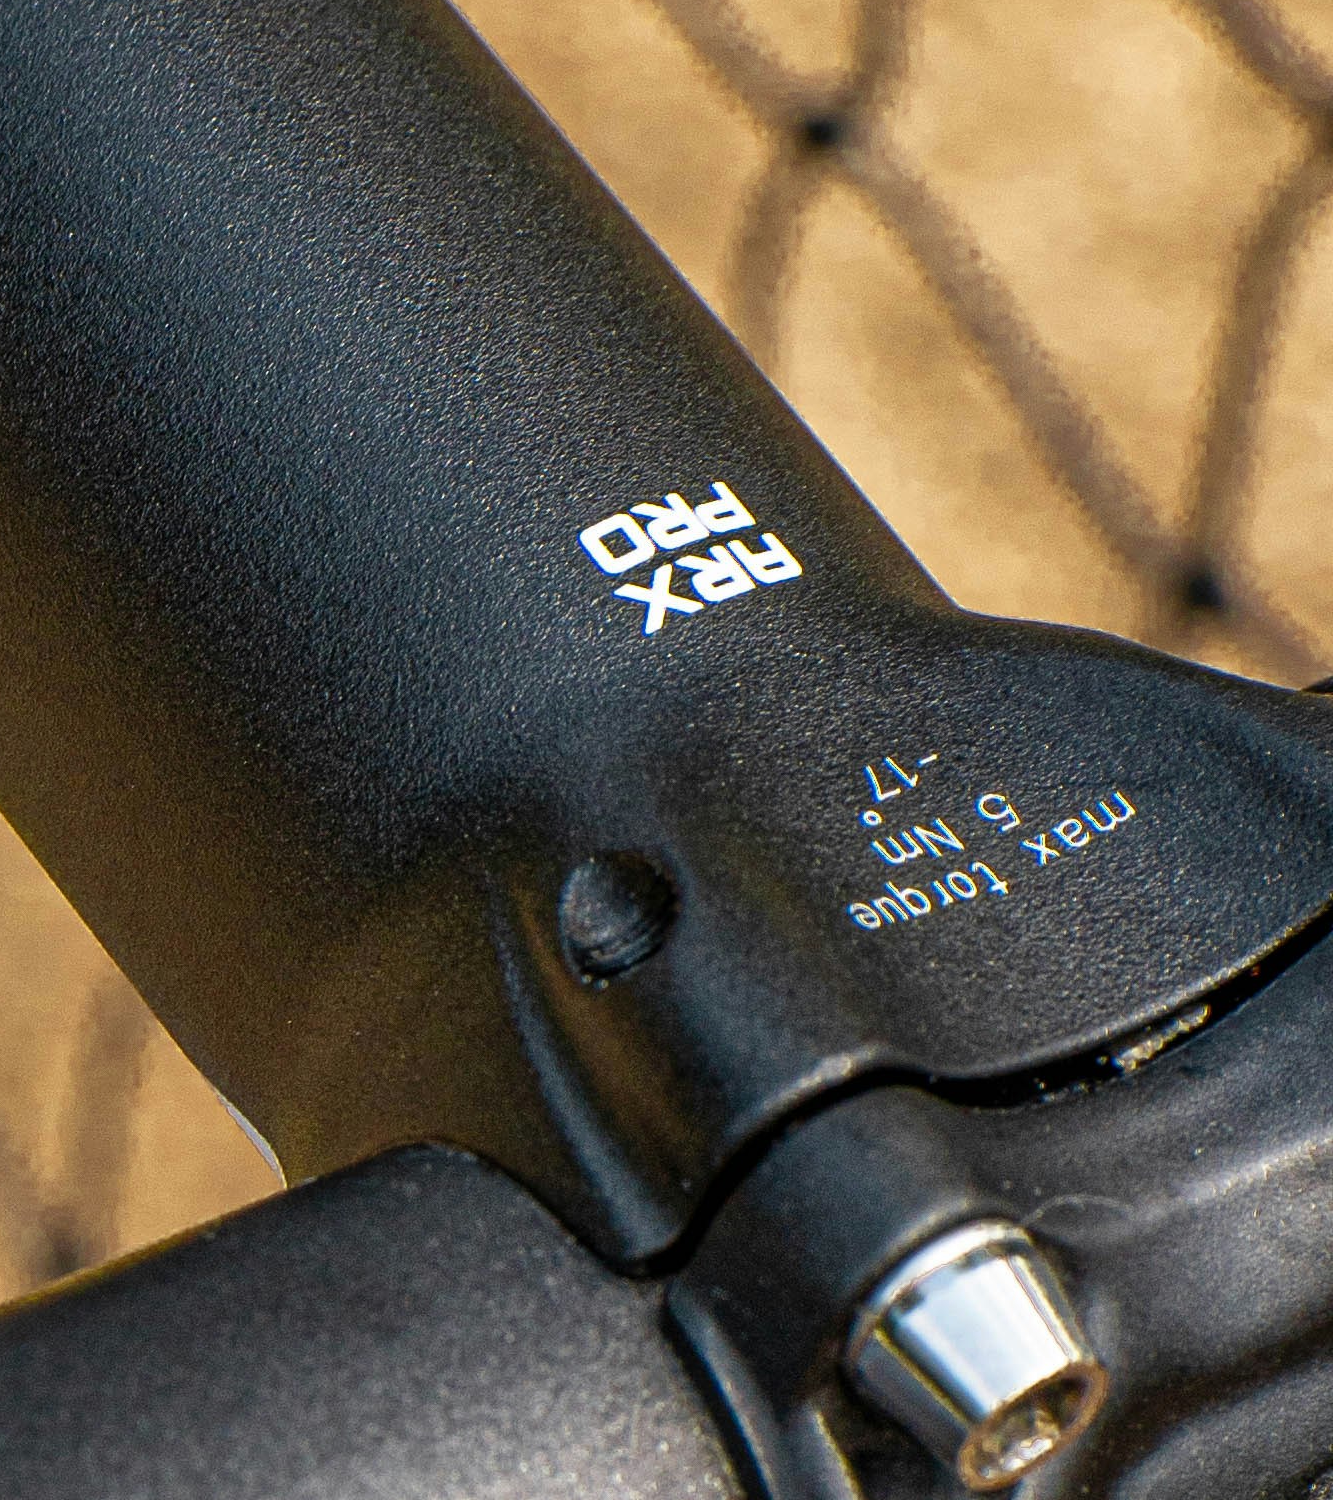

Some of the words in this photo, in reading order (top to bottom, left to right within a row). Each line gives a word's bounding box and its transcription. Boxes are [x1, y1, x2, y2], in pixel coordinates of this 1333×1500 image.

[580, 481, 756, 575] PRO
[615, 533, 803, 636] ARX
[870, 818, 966, 866] Nm
[976, 793, 1021, 833] 5
[1021, 792, 1136, 866] max
[849, 860, 1010, 931] torque
